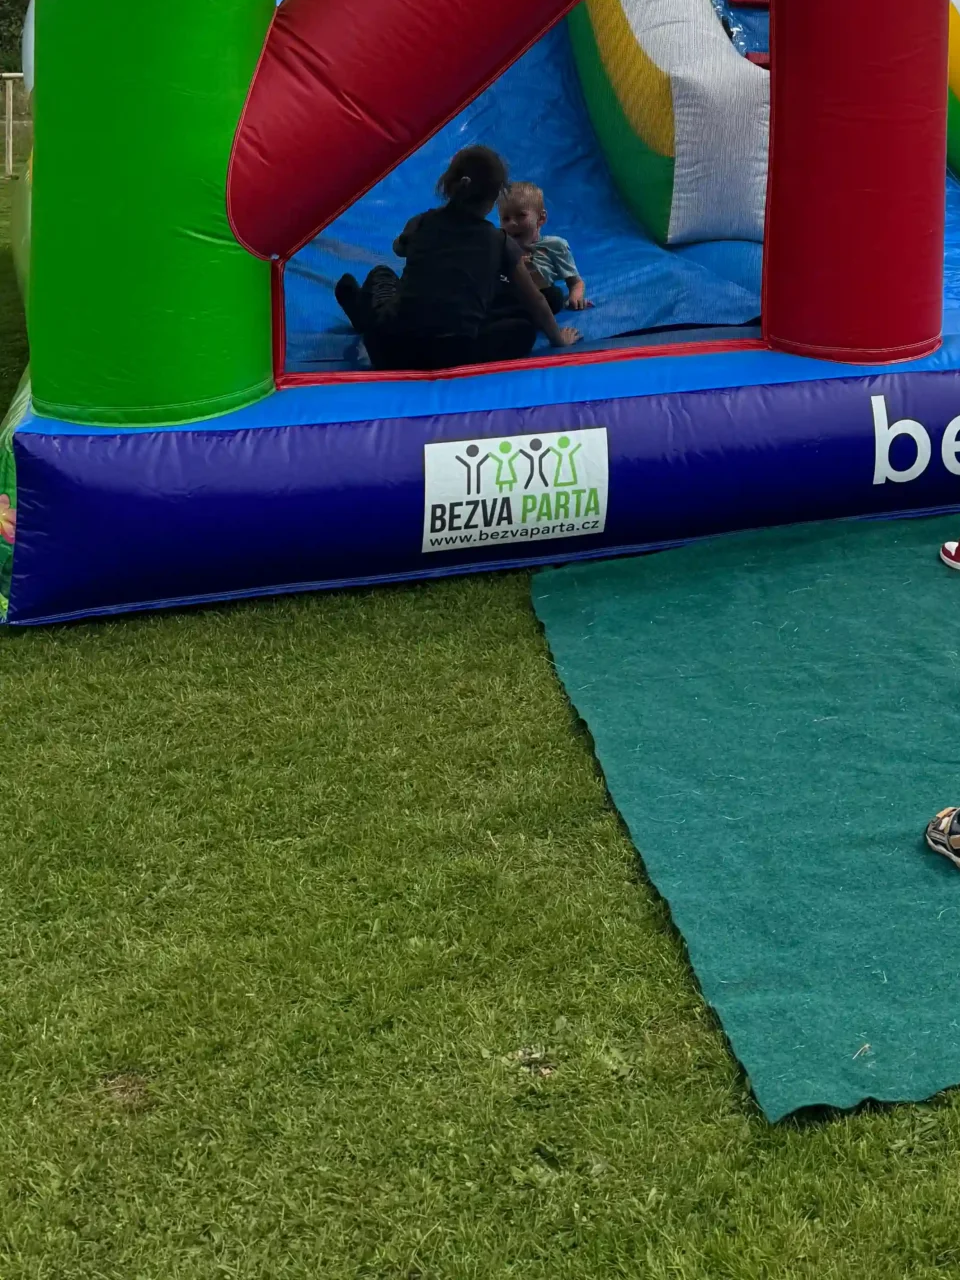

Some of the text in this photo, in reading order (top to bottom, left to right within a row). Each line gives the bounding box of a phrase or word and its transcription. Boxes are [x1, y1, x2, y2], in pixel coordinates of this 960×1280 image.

[430, 487, 600, 534] BEZVA PARTA
[430, 520, 599, 547] www.bezvaparta.cz
